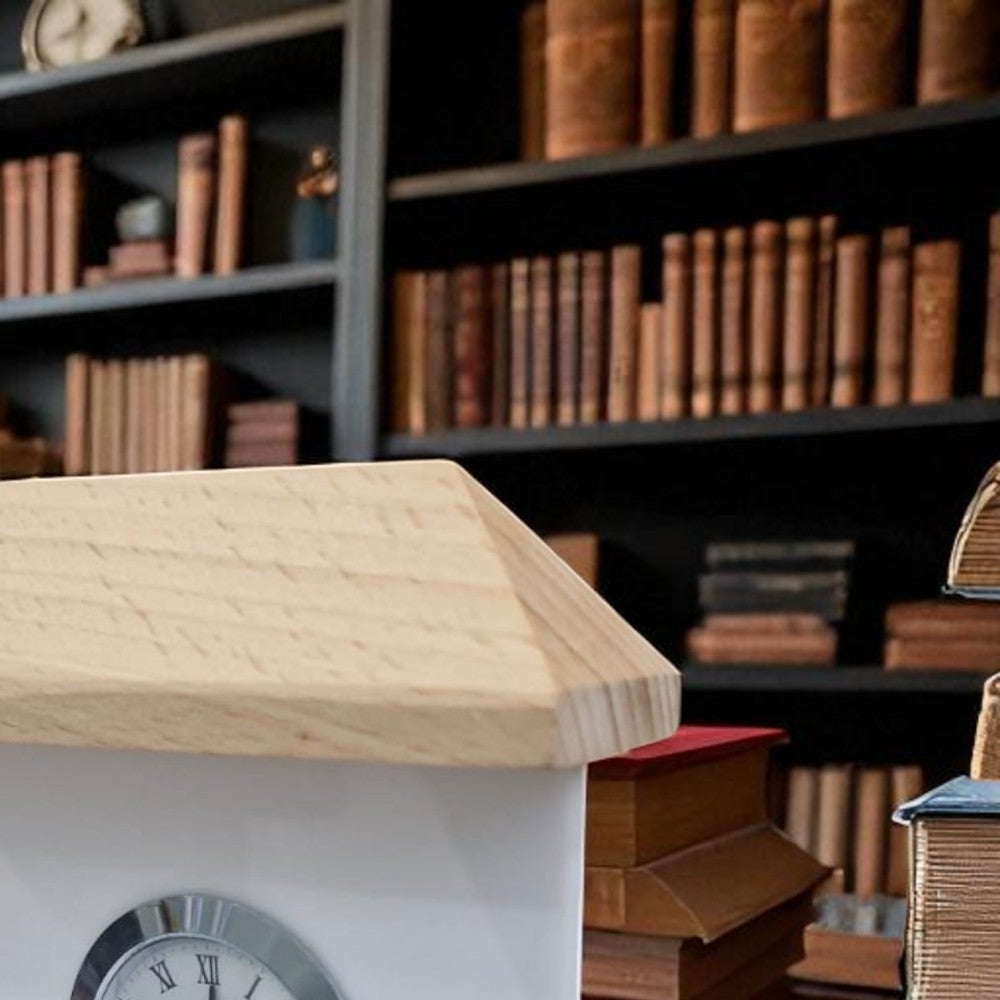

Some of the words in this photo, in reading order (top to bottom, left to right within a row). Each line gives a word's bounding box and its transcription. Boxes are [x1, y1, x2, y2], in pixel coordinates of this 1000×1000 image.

[149, 960, 177, 994] XI
[196, 953, 220, 986] XII
[244, 976, 262, 1000] I
